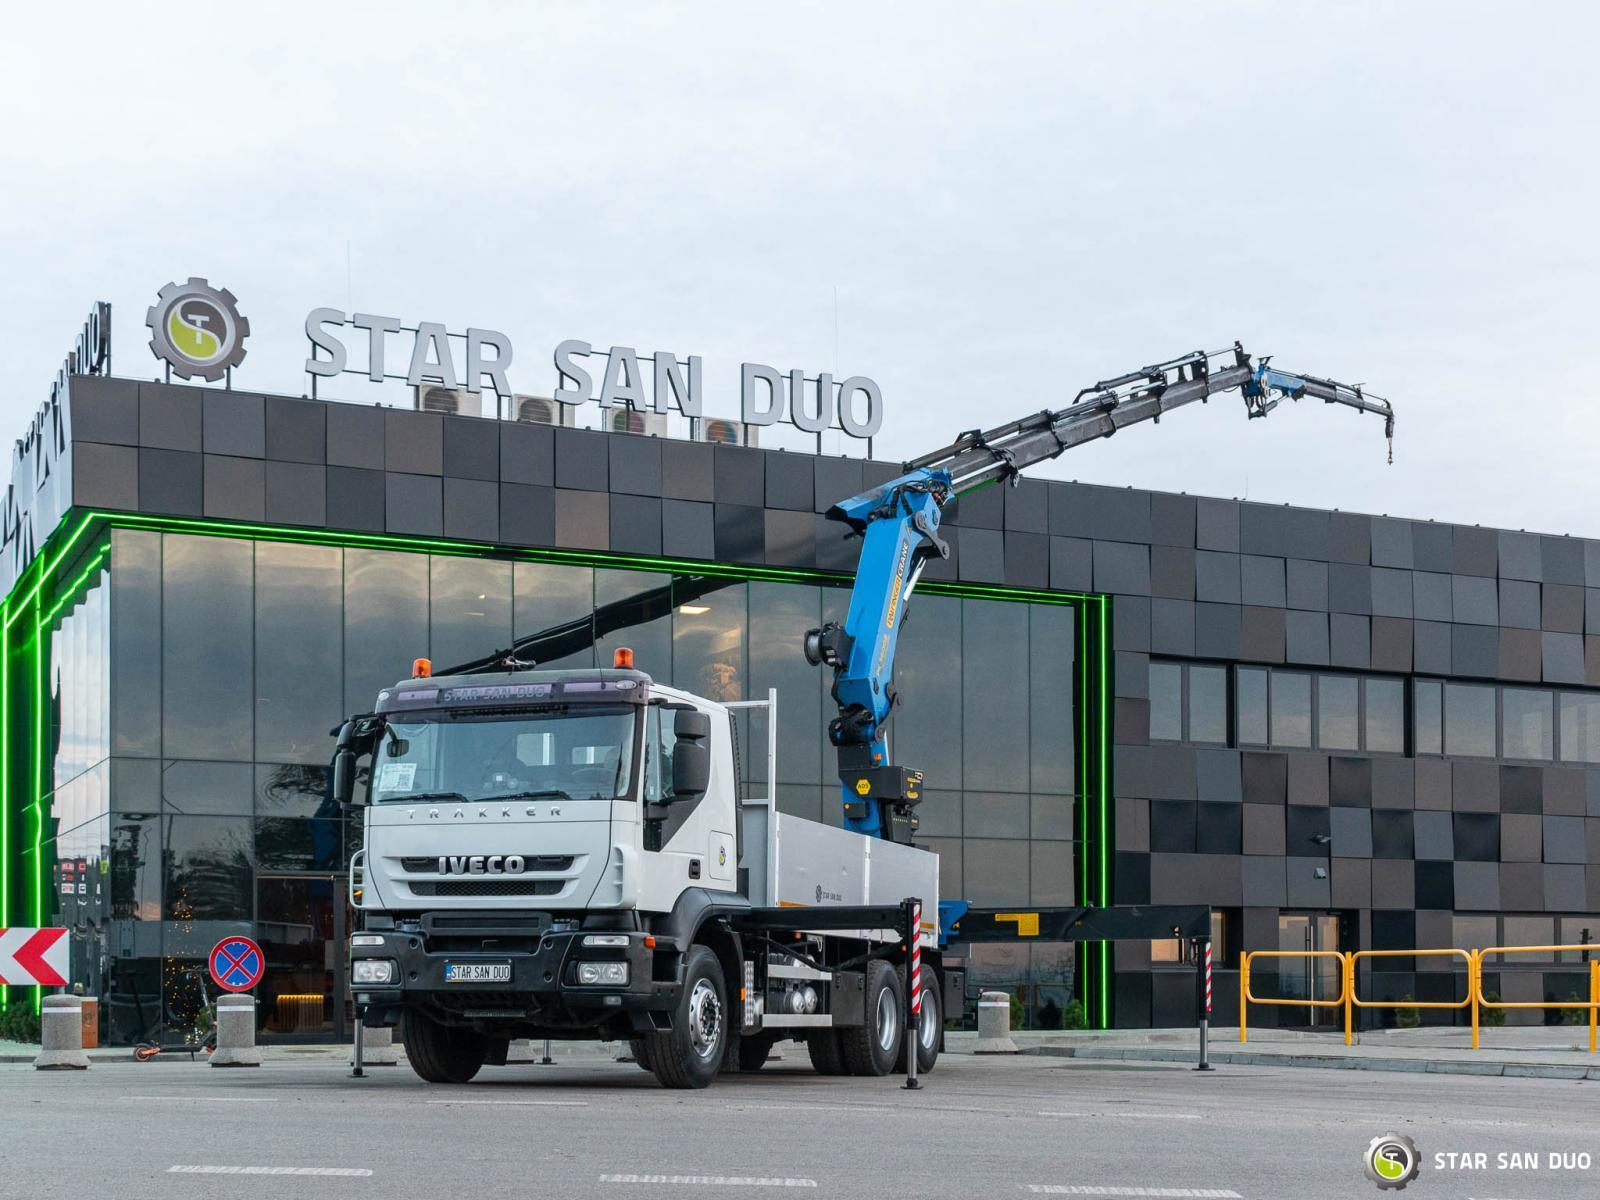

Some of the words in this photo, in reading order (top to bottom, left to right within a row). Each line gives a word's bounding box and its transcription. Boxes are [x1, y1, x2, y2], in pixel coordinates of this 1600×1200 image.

[305, 307, 513, 397] STAR
[554, 339, 702, 418] SAN
[741, 362, 883, 438] DUO
[444, 687, 480, 702] STAR
[483, 686, 512, 700] SAN
[516, 685, 545, 699] DUO
[407, 806, 562, 819] TRAKKER
[438, 855, 525, 875] IVECO
[451, 966, 472, 979] STAR
[474, 966, 490, 979] SAN
[493, 966, 510, 979] DUO
